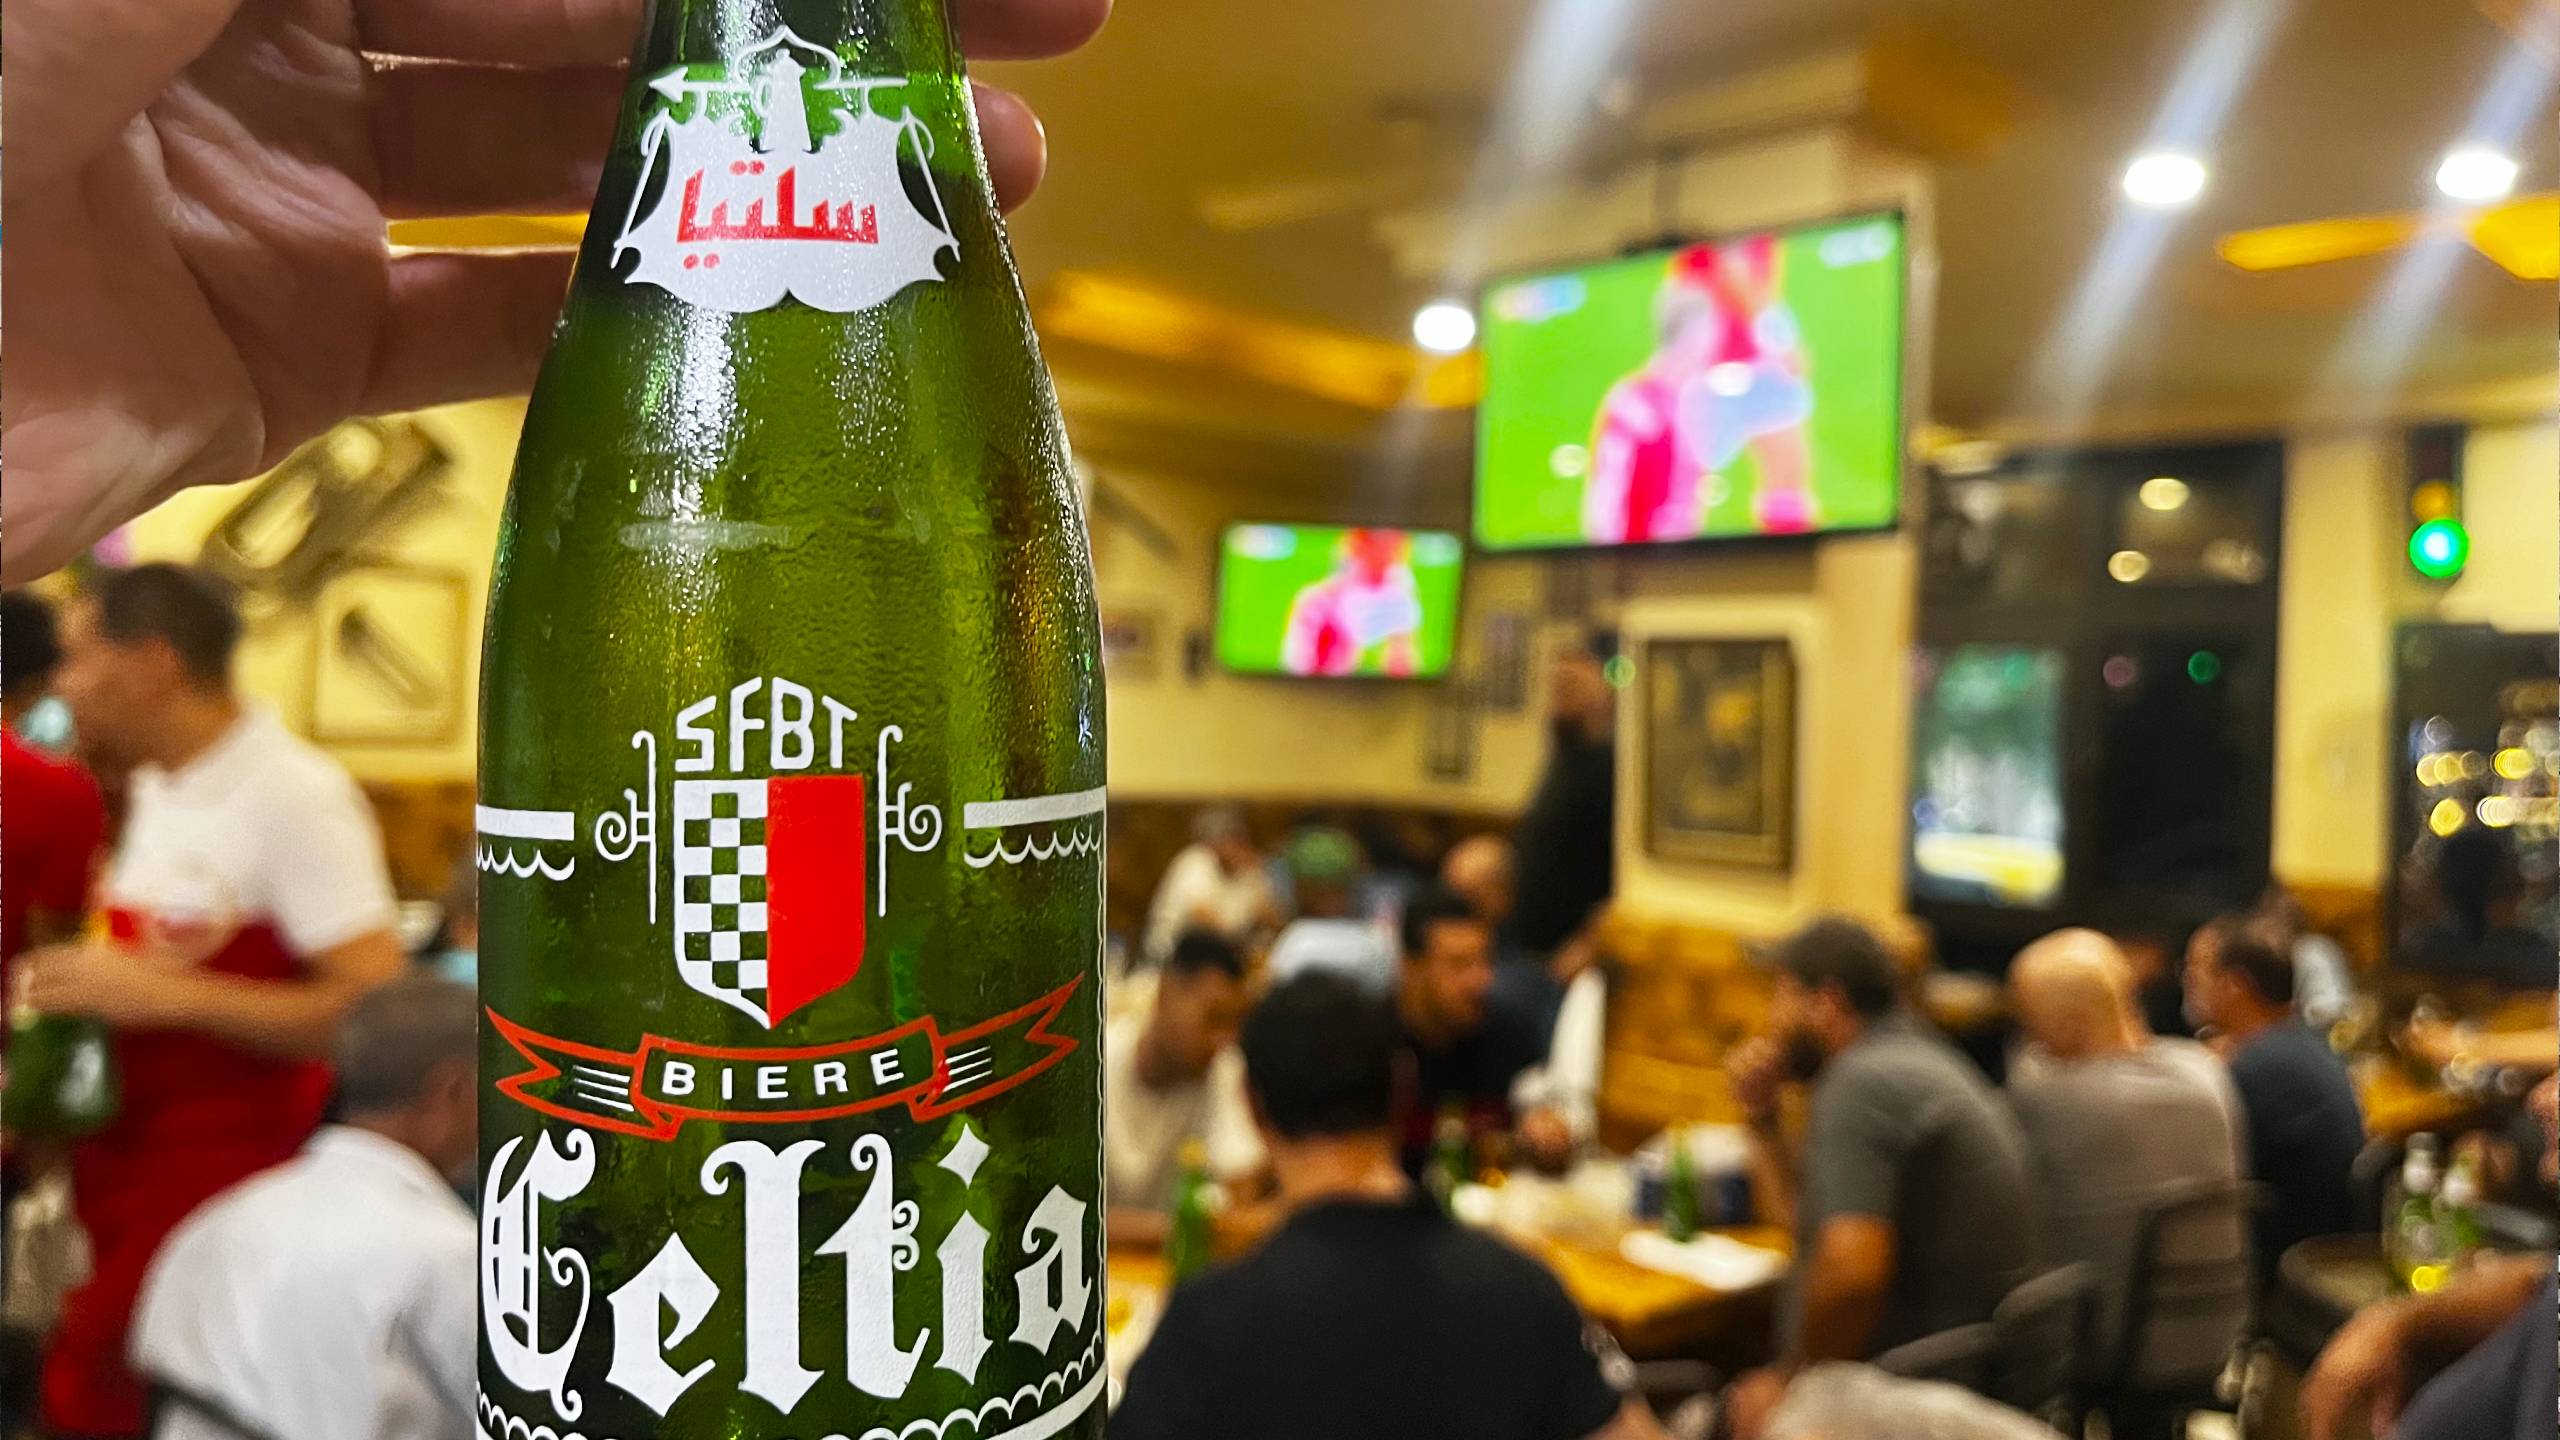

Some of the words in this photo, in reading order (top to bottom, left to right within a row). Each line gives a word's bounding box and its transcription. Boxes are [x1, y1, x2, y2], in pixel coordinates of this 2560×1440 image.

[677, 160, 879, 270] سلتيا
[674, 676, 858, 773] SFBT
[661, 1048, 904, 1100] BIERE
[481, 1122, 1092, 1422] Celtia
